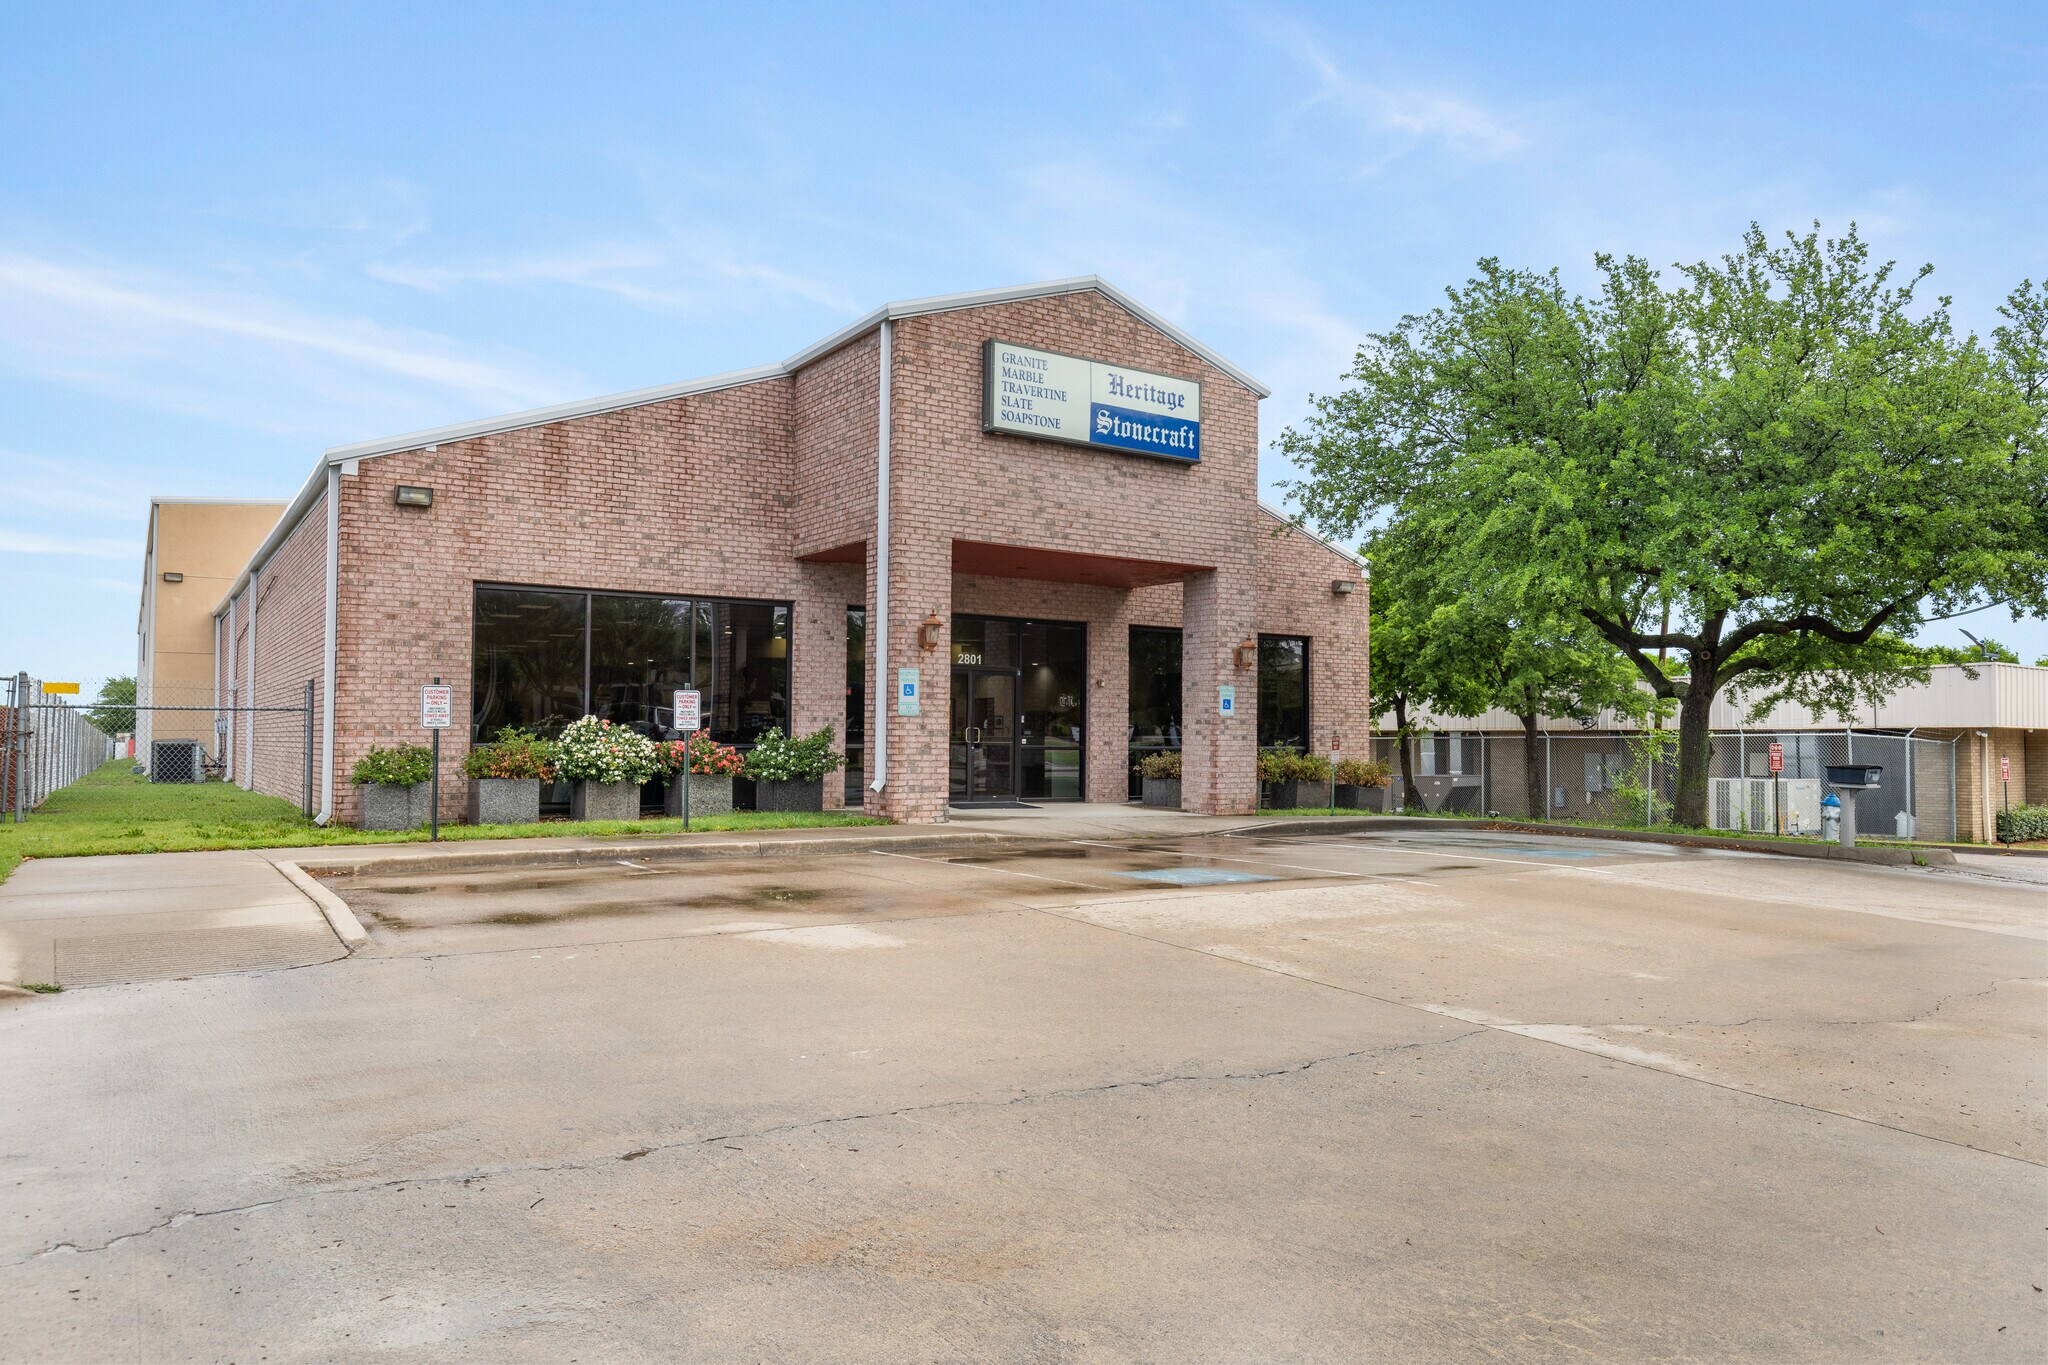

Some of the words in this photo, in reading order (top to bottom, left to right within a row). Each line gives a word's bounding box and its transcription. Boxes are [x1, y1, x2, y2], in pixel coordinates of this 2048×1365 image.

[1001, 352, 1048, 371] GRANITE
[1001, 366, 1044, 384] MARBLE
[1001, 380, 1068, 402] TRAVERTINE
[1107, 373, 1185, 411] Heritage
[1001, 395, 1033, 410] SLATE
[1001, 409, 1061, 430] SOAPSTONE
[1095, 409, 1195, 450] Stonecraft
[957, 653, 982, 665] 2801
